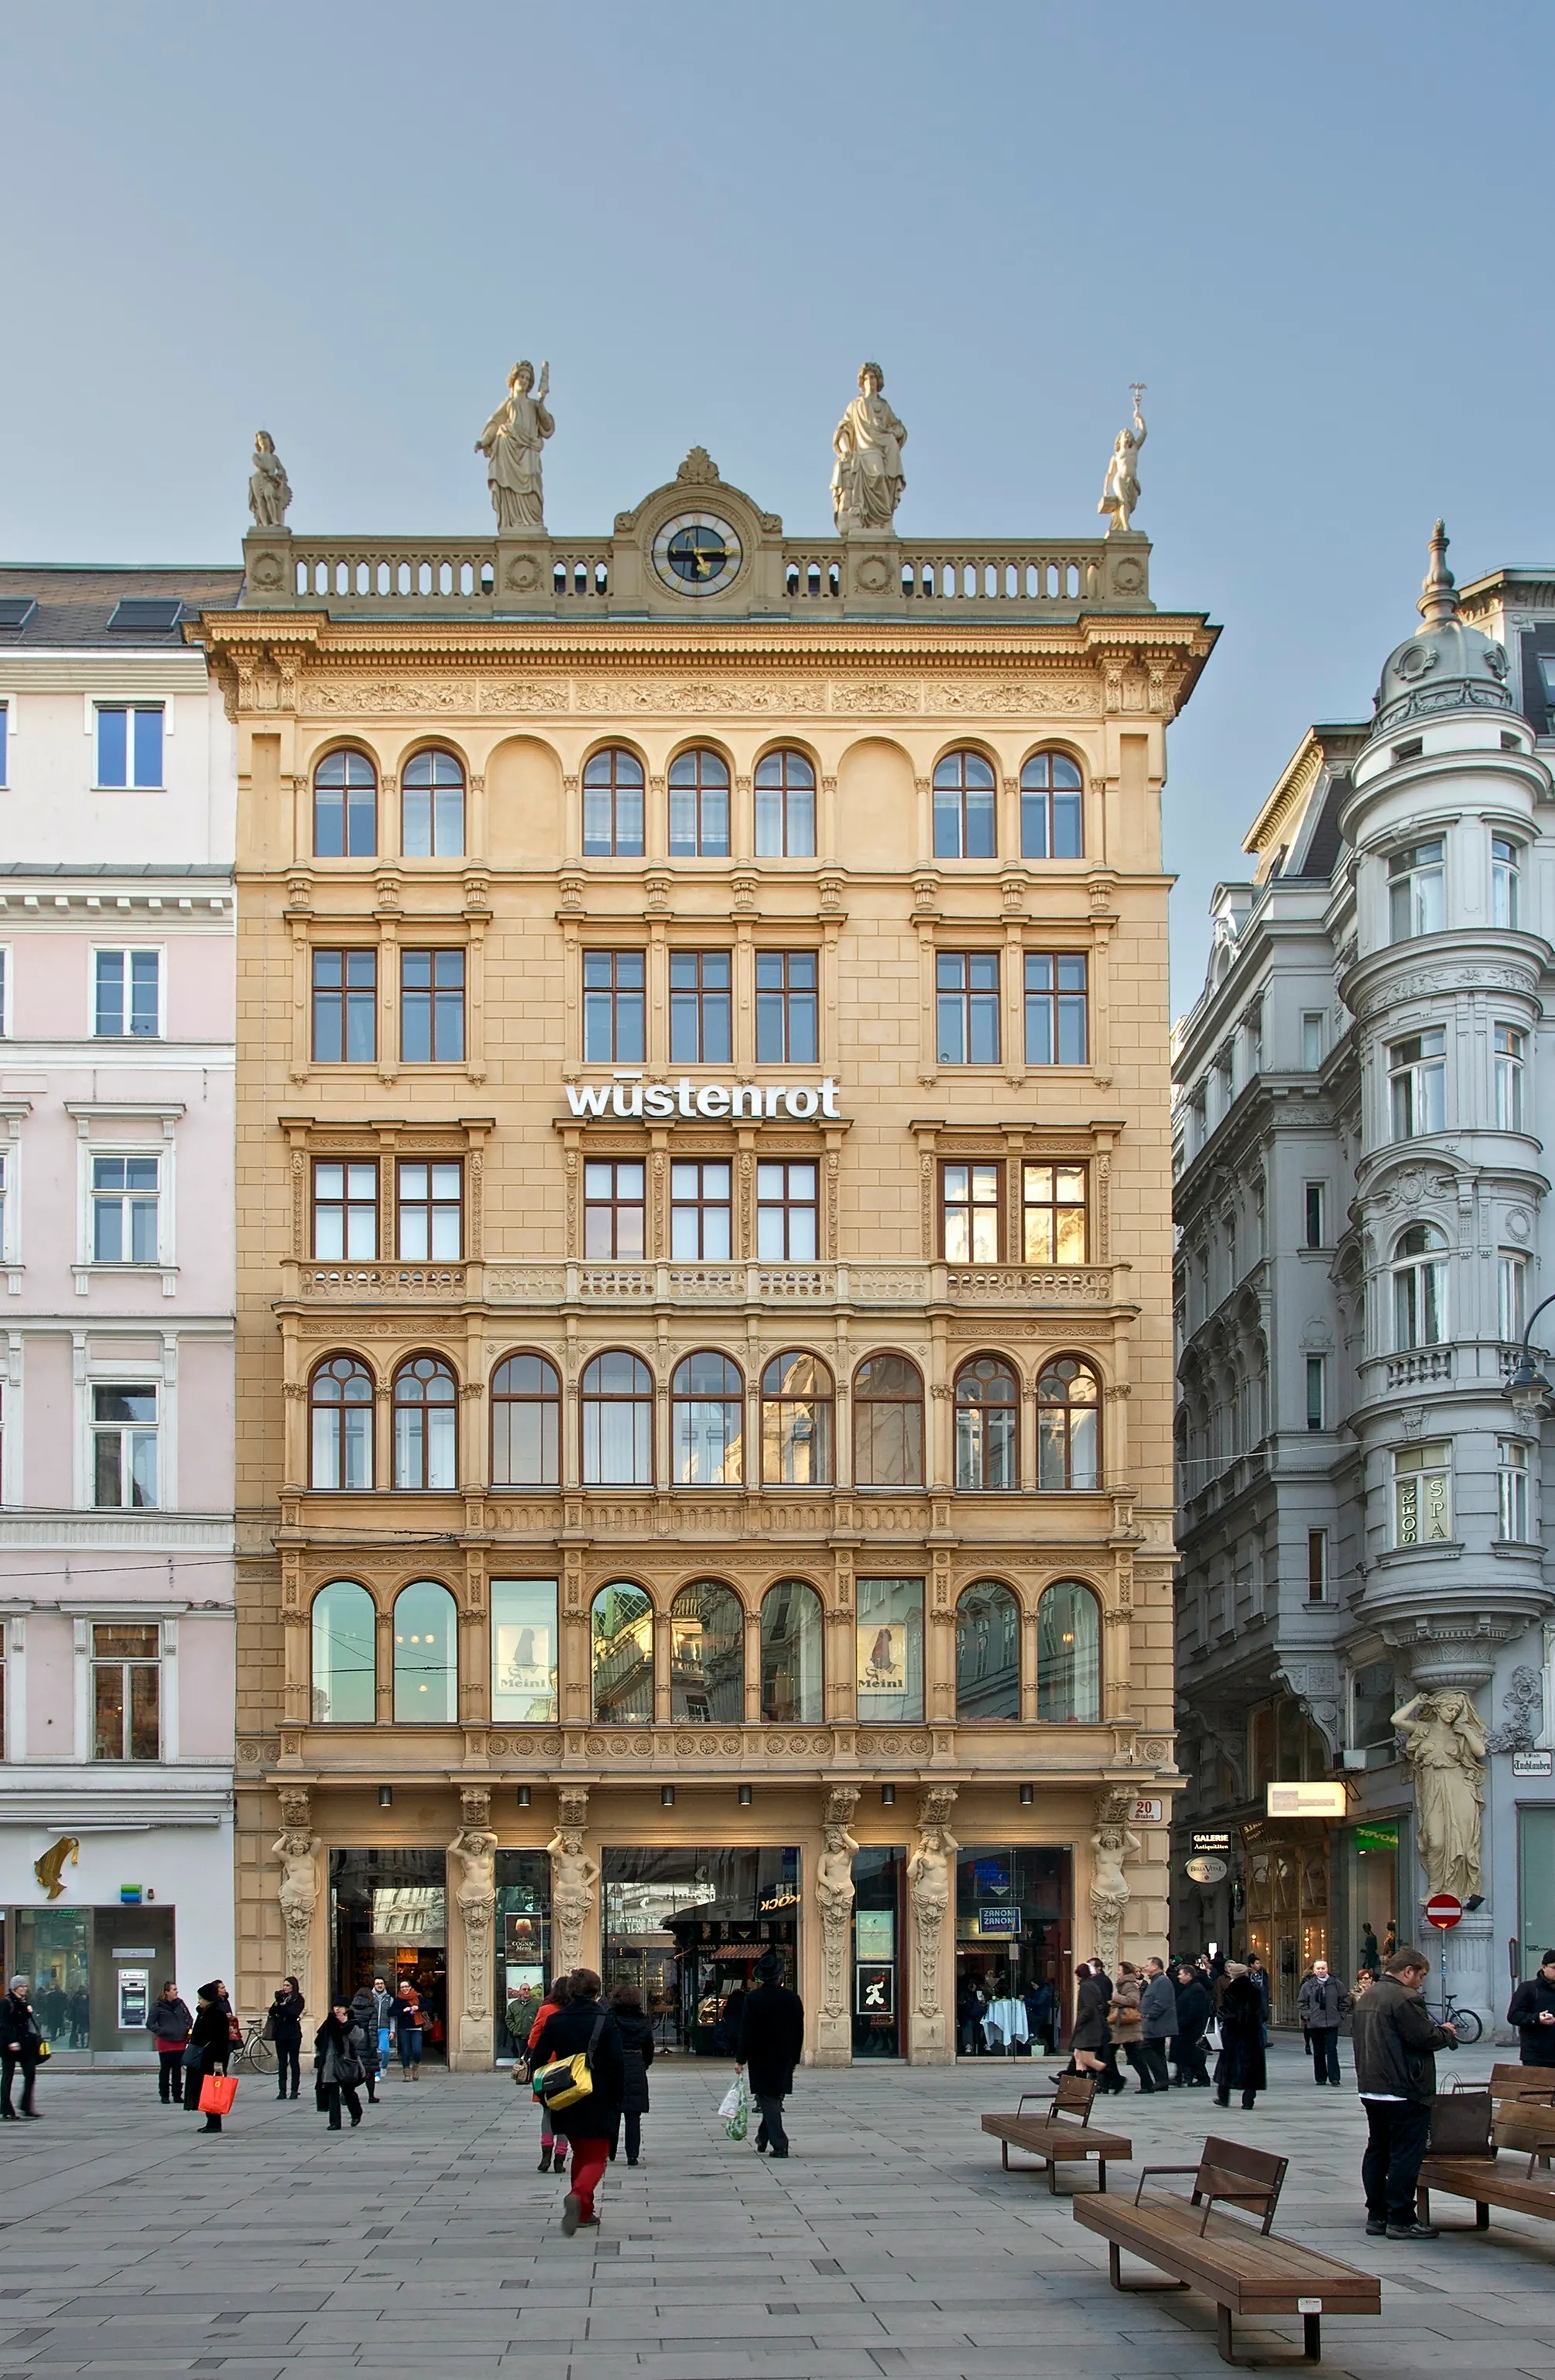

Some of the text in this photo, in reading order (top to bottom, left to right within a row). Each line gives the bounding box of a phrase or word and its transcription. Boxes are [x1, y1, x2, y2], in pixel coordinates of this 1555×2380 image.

[1429, 1480, 1447, 1539] SPA
[501, 1679, 546, 1687] Meinl
[858, 1679, 903, 1688] Meinl
[1135, 1801, 1152, 1813] 20
